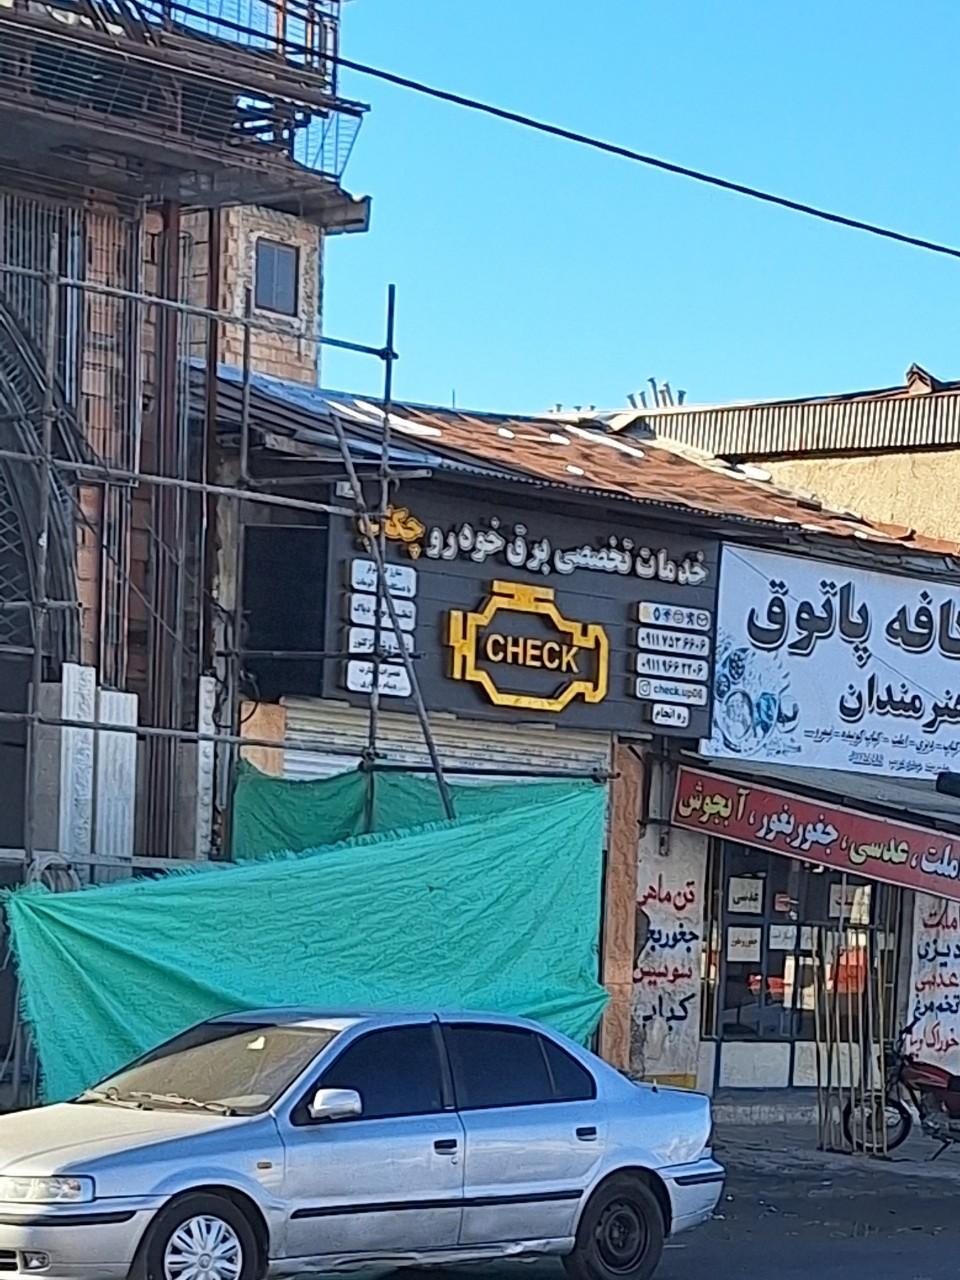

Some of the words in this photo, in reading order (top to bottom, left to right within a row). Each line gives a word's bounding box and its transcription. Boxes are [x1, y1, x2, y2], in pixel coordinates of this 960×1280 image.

[426, 516, 505, 563] خودرو
[506, 523, 551, 575] برق
[553, 535, 634, 574] تخصصی
[636, 547, 708, 586] خدمات
[746, 579, 874, 667] پاتوق
[485, 633, 580, 674] CHECK
[641, 992, 696, 1032] کباب
